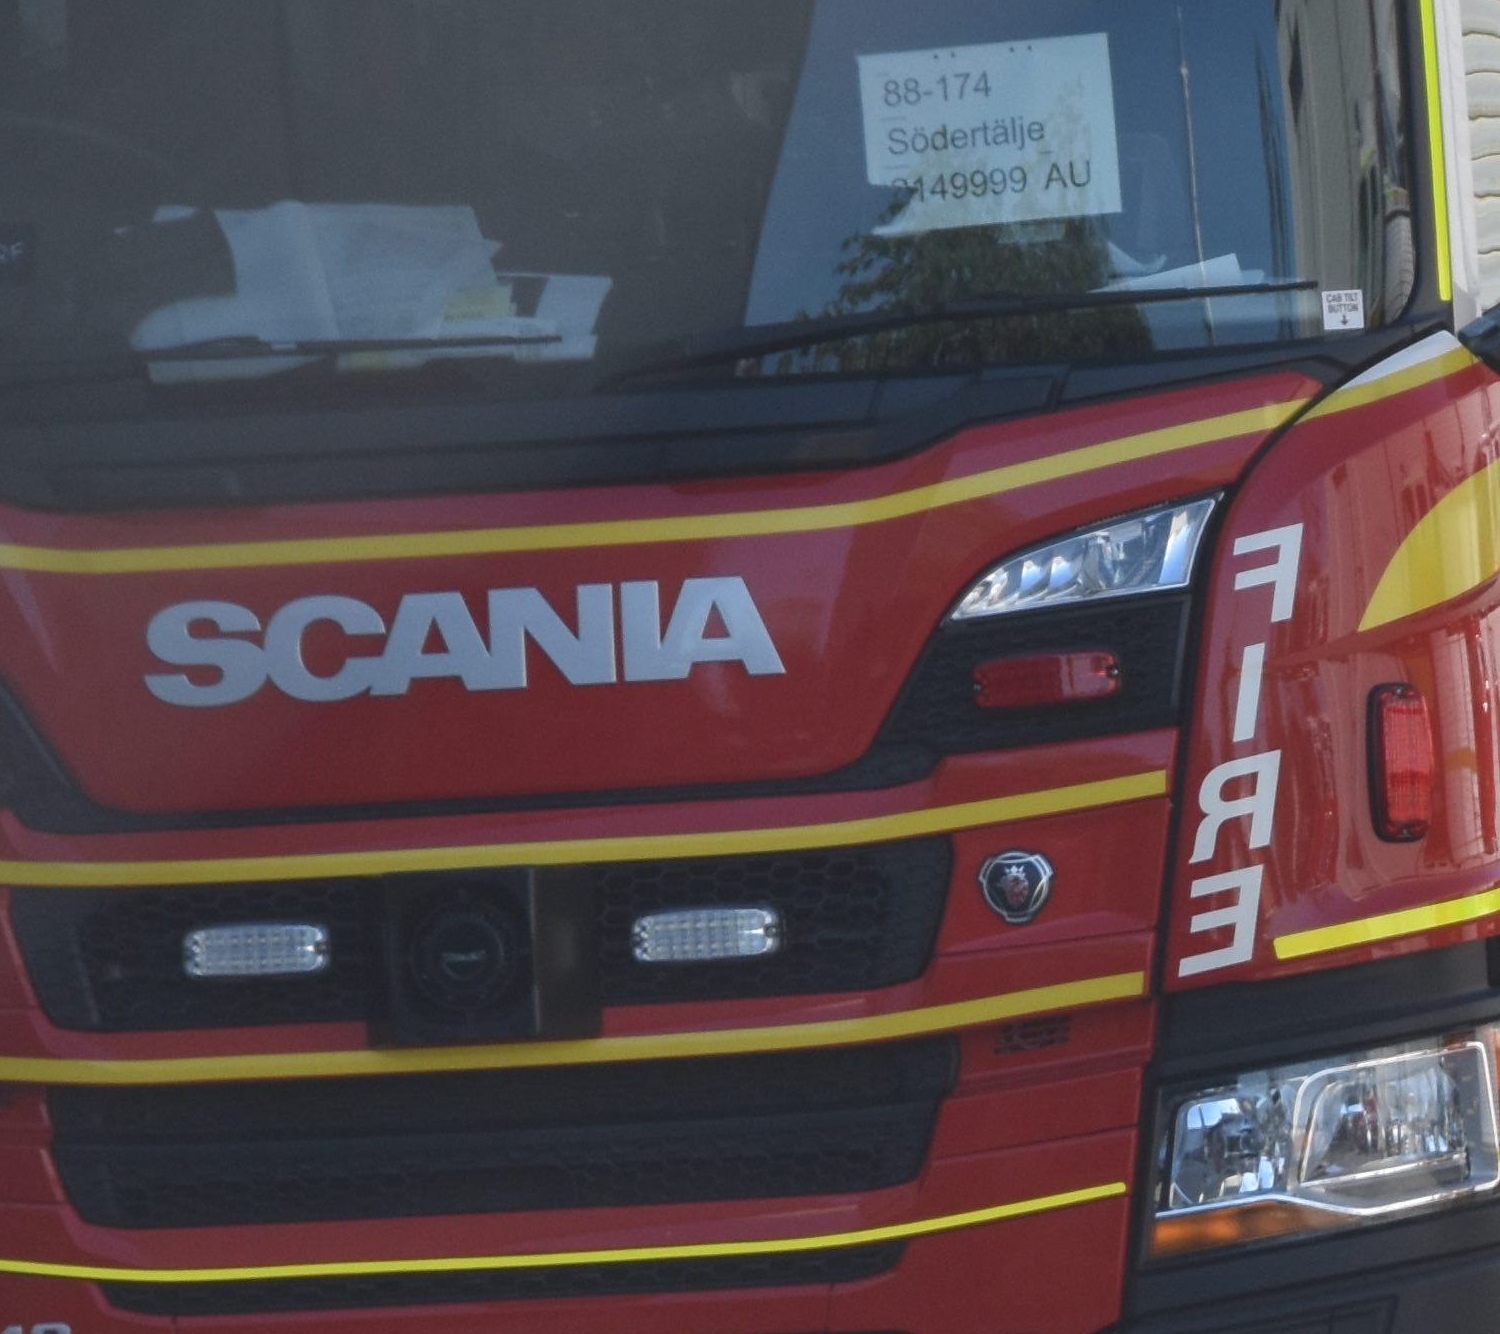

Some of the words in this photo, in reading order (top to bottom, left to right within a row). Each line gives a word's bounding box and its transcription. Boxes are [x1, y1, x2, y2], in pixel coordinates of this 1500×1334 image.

[883, 70, 992, 108] 88-174
[887, 116, 1046, 157] Södertälje
[1043, 160, 1092, 190] AU
[1325, 293, 1342, 303] CAB
[145, 575, 787, 708] SCANIA
